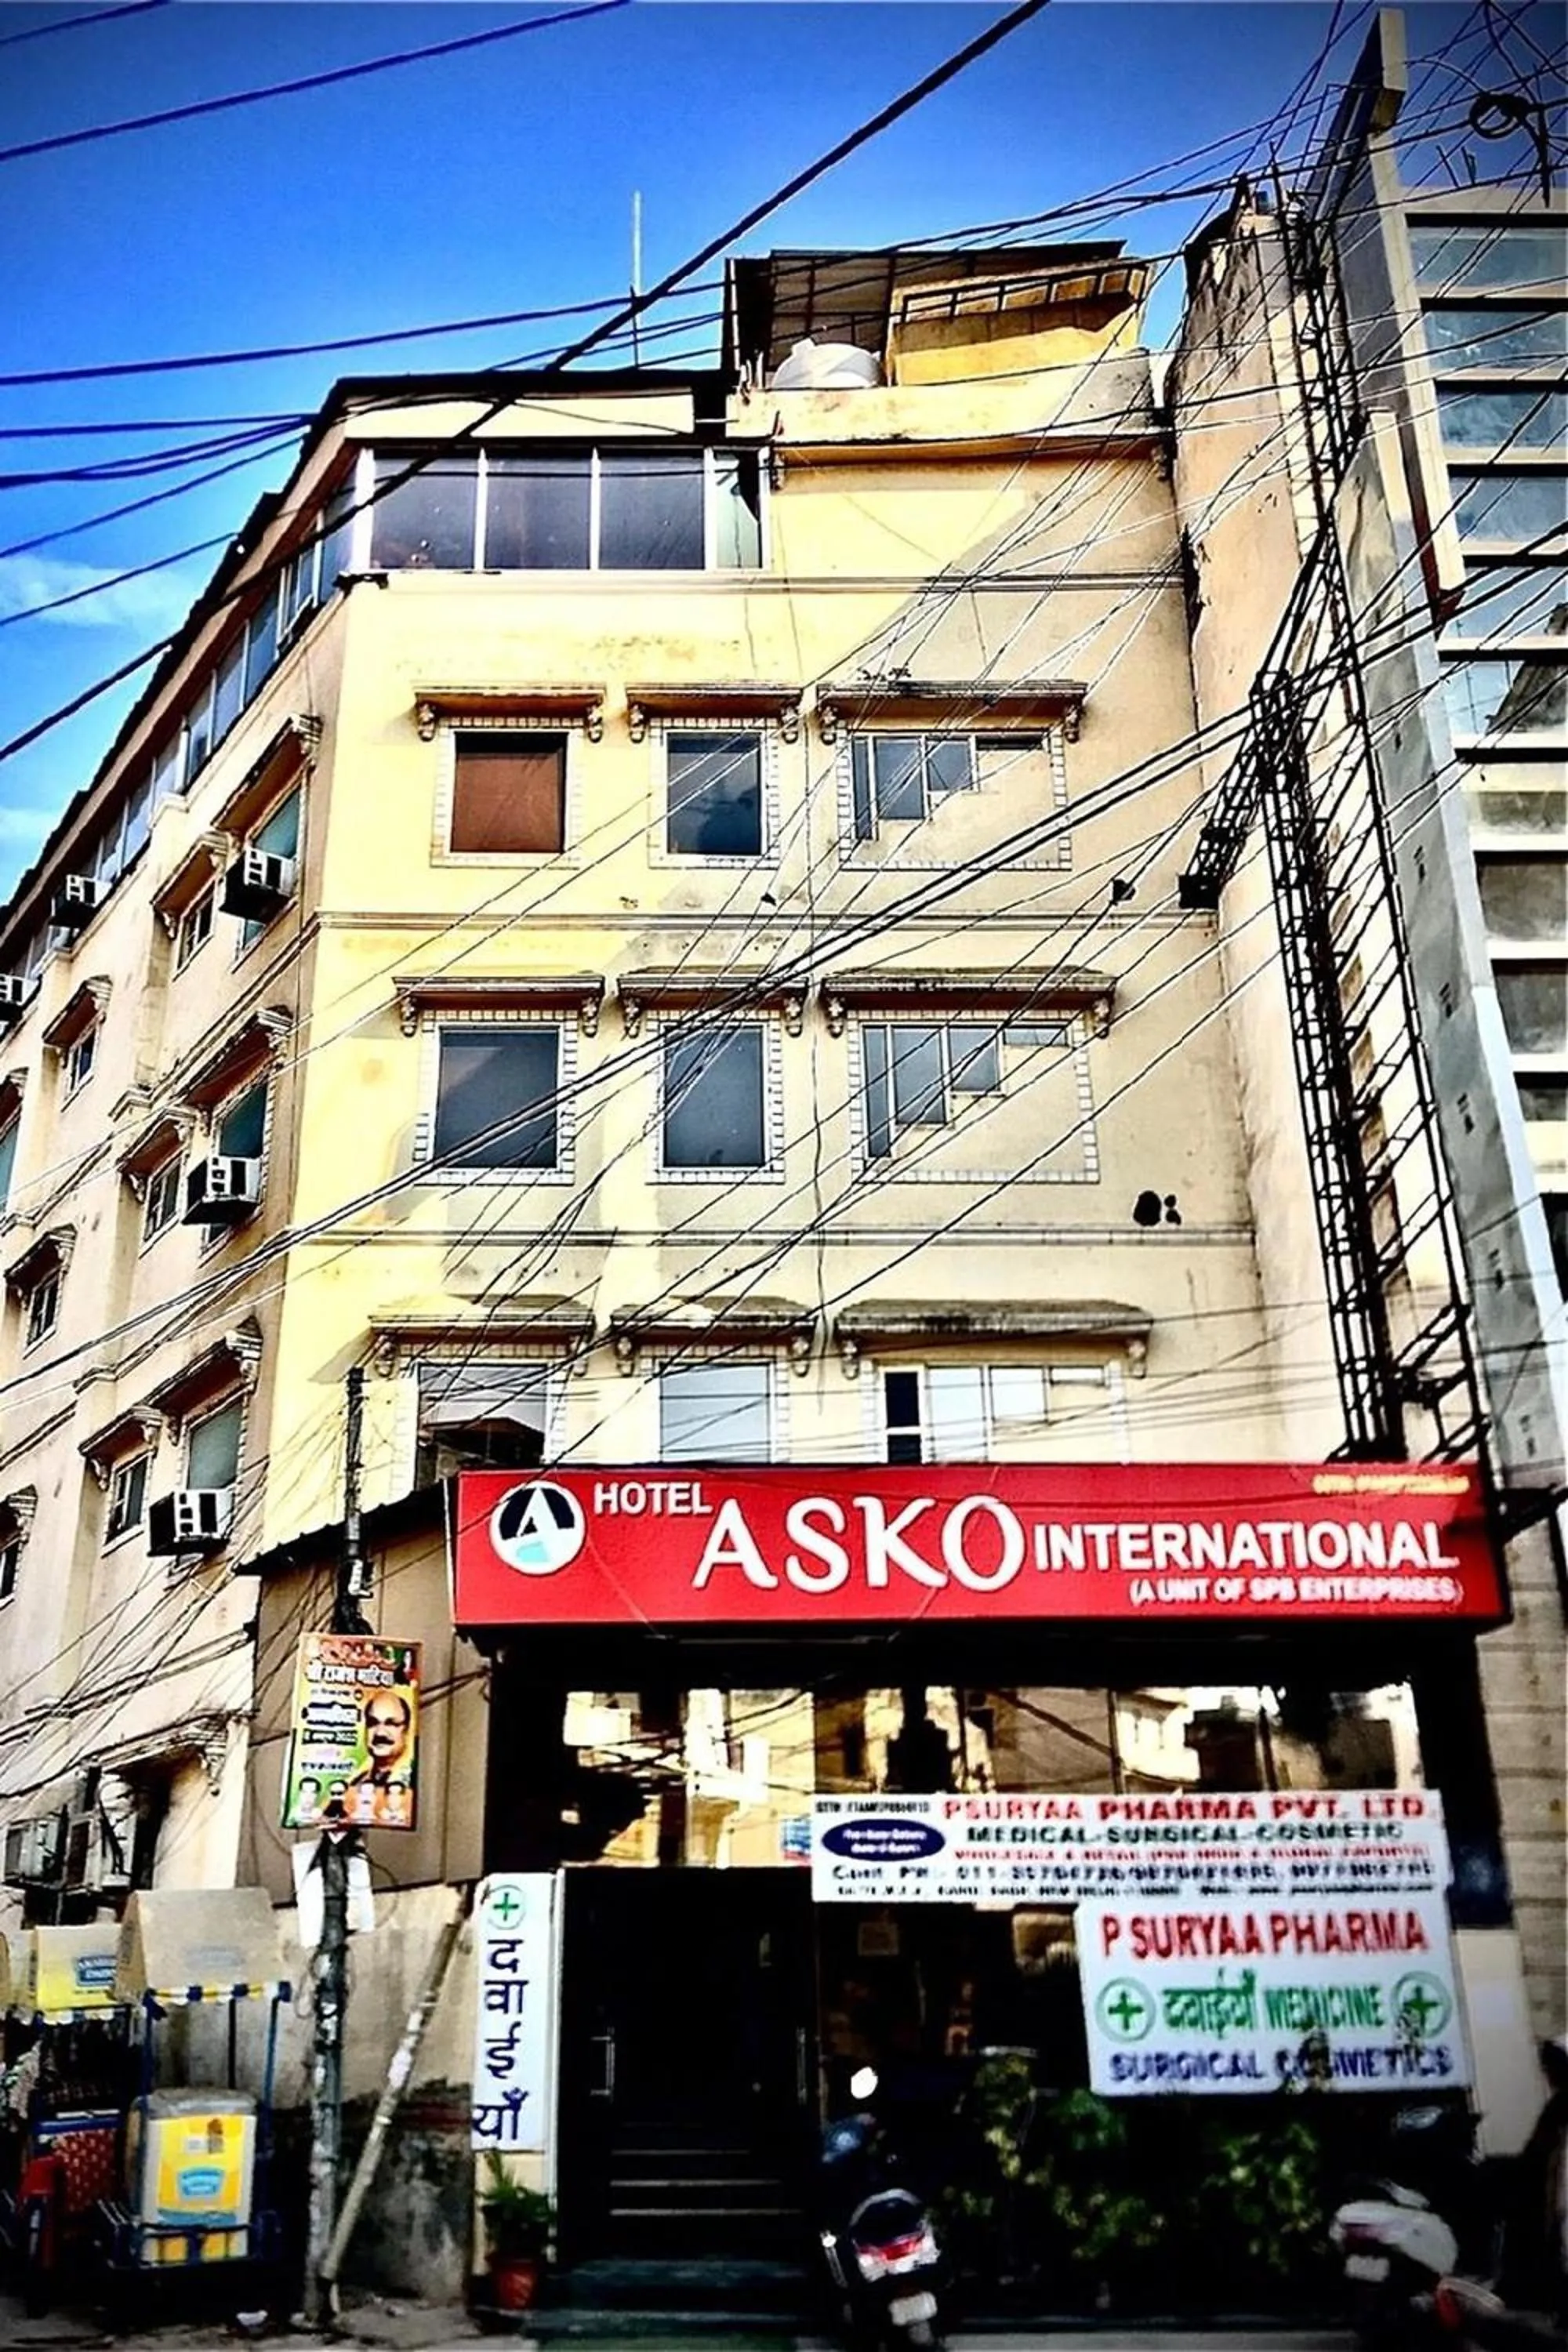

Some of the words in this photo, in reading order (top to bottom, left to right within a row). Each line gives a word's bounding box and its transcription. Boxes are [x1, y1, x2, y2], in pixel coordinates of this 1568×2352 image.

[593, 1482, 713, 1515] HOTEL
[691, 1494, 1025, 1593] ASKO
[1034, 1521, 1461, 1570] INTERNATIONAL
[1157, 1577, 1210, 1602] UNIT
[1214, 1577, 1247, 1602] OF
[1099, 1798, 1258, 1820] PHARMA
[1268, 1908, 1431, 1955] PHARMA
[1264, 1983, 1385, 2031] MEDICINE
[1109, 2048, 1265, 2082] SURGICAL
